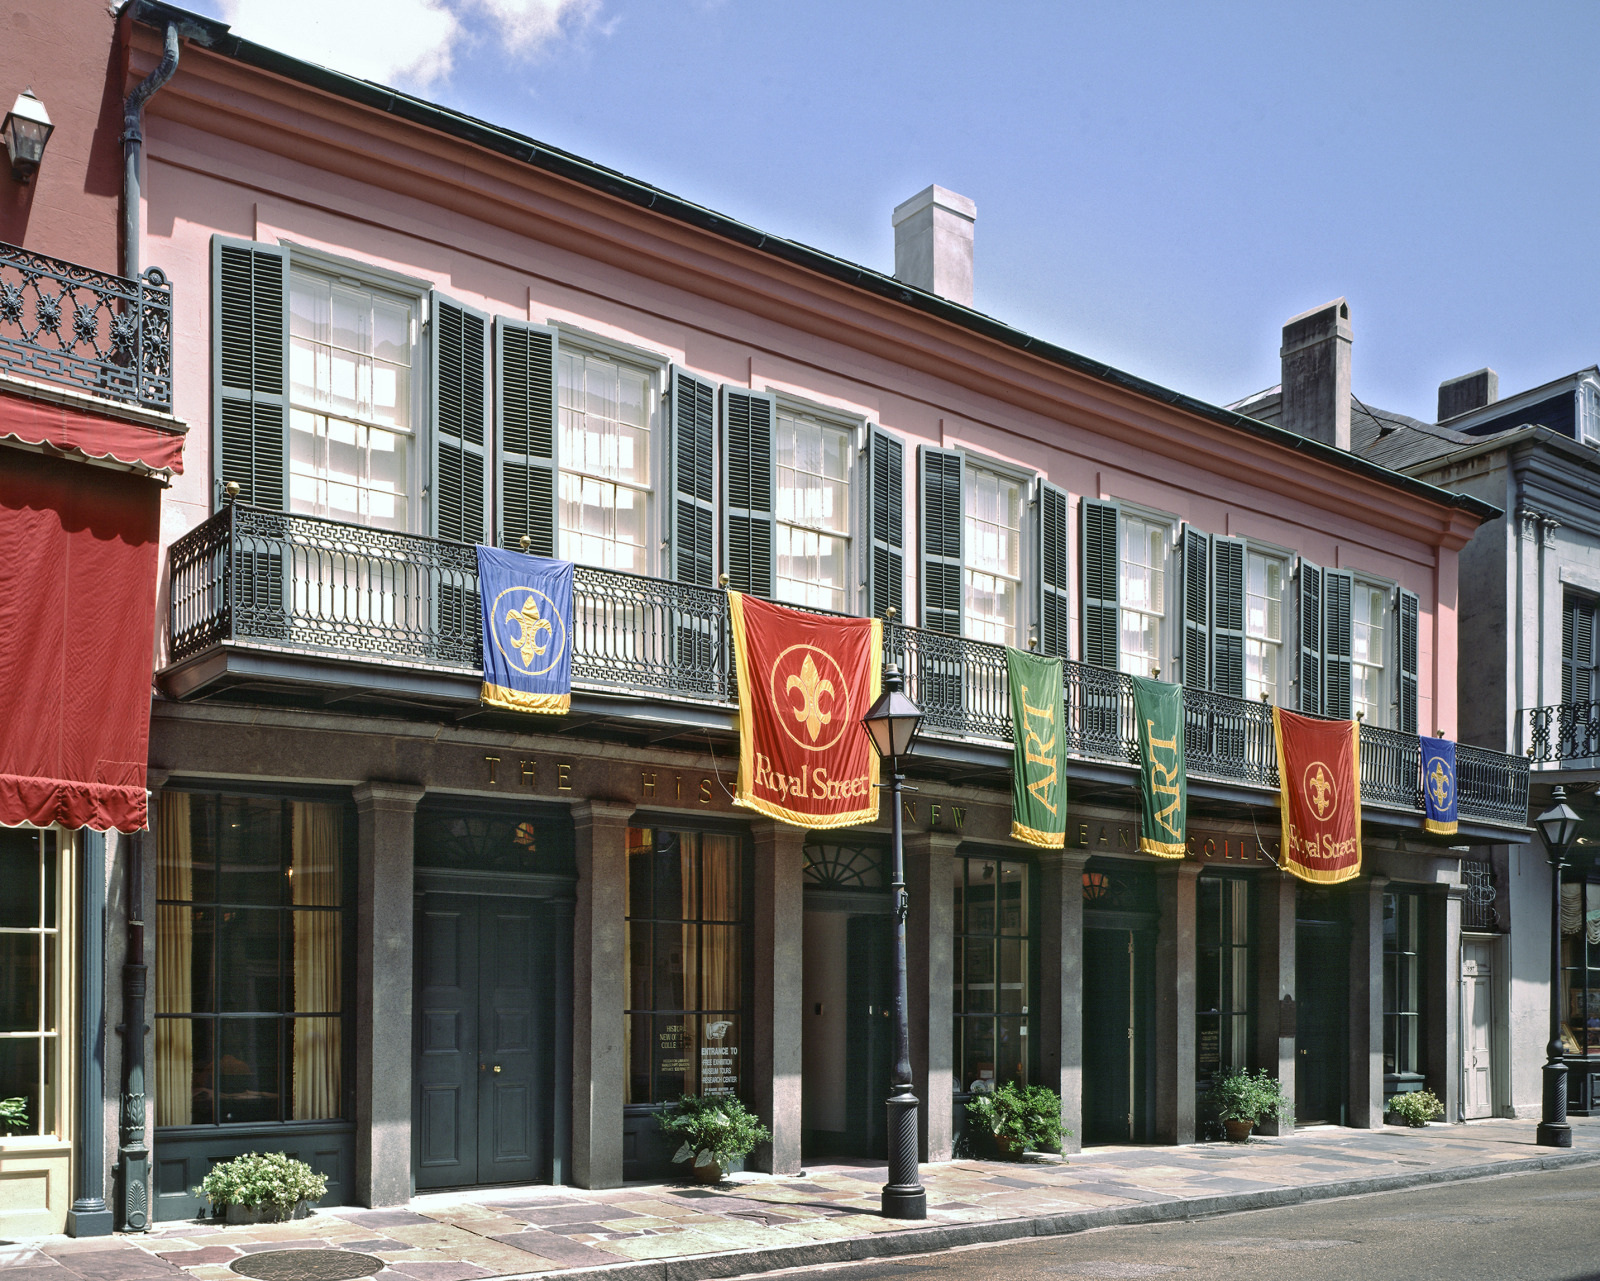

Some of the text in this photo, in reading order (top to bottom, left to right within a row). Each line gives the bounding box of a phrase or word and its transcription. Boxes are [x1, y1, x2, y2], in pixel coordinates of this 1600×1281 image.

[755, 752, 868, 802] Royal Street
[1021, 685, 1058, 817] ART
[1147, 719, 1182, 842] ART
[485, 756, 572, 790] THE
[903, 800, 969, 829] NEW
[701, 1046, 738, 1056] ENTRANCE TO
